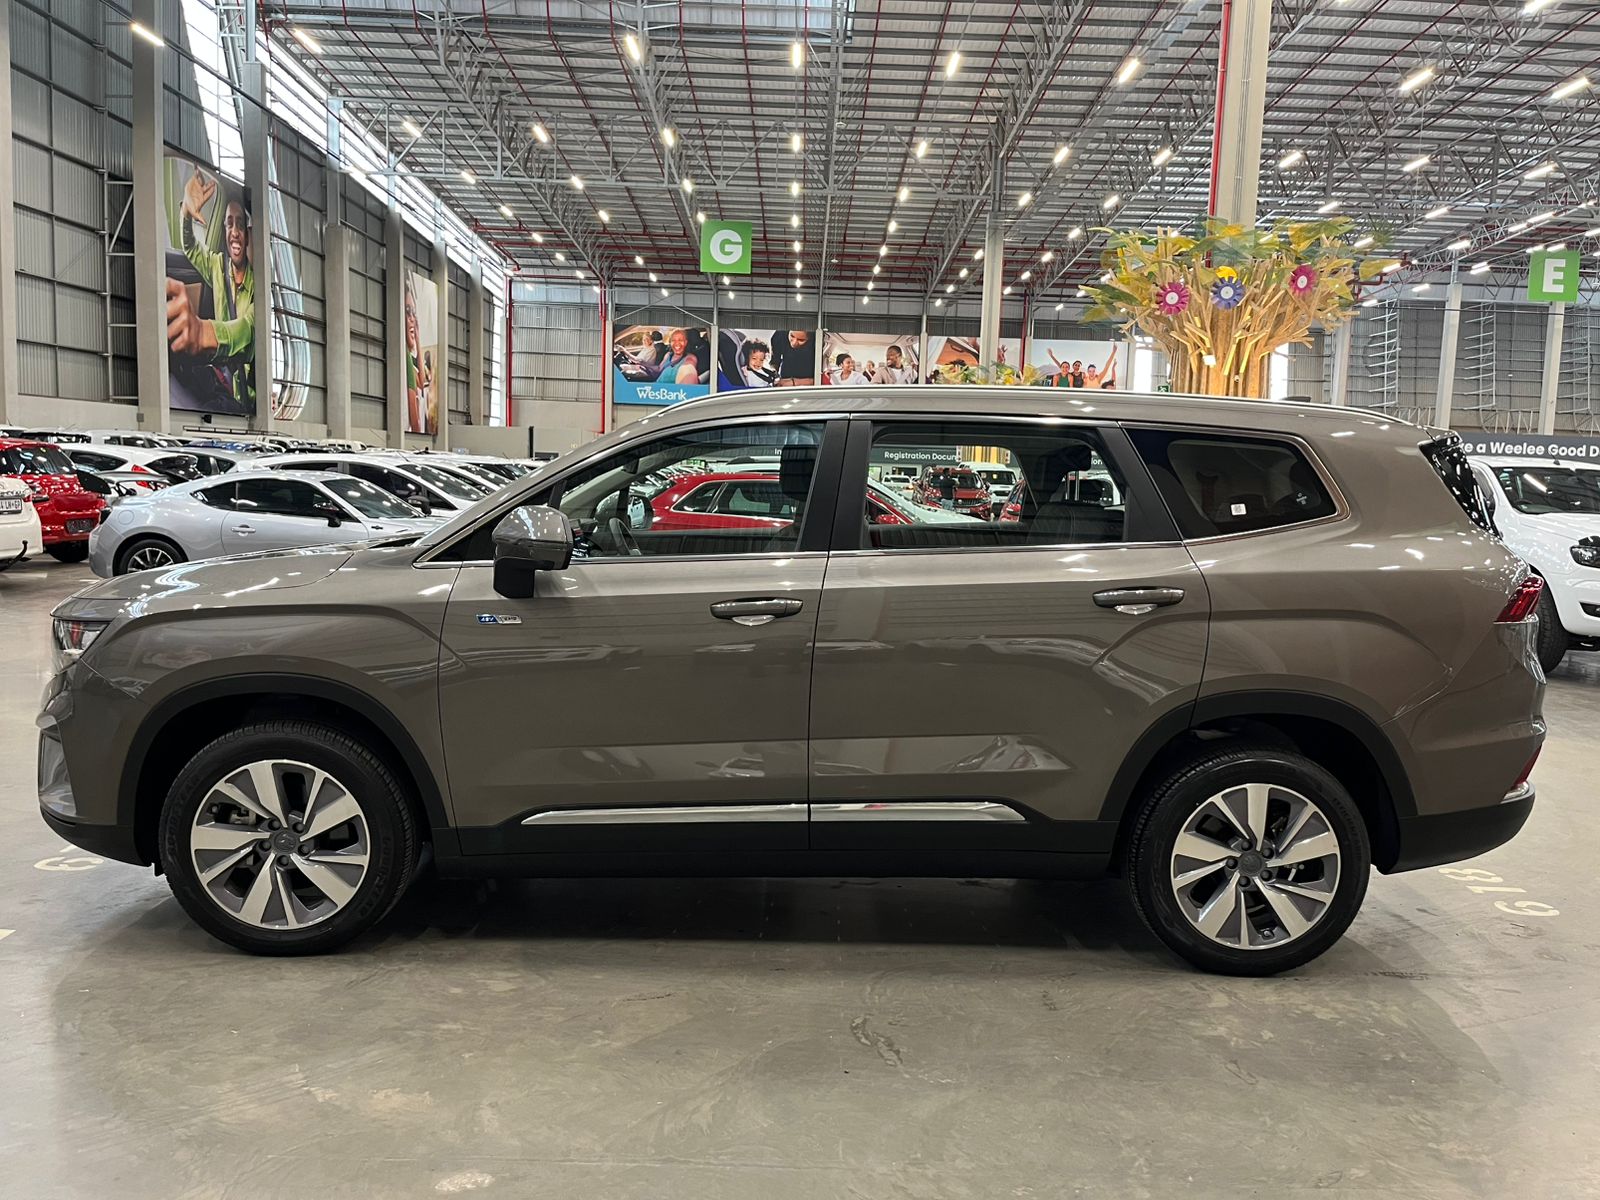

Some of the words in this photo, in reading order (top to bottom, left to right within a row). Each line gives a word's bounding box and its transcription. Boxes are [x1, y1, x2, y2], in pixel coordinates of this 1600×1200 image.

[710, 229, 742, 264] G
[1543, 258, 1566, 293] E
[636, 386, 687, 400] WesBank
[884, 451, 931, 461] Registration
[1476, 443, 1486, 453] a
[1490, 442, 1544, 455] Weelee
[1548, 444, 1586, 457] Good
